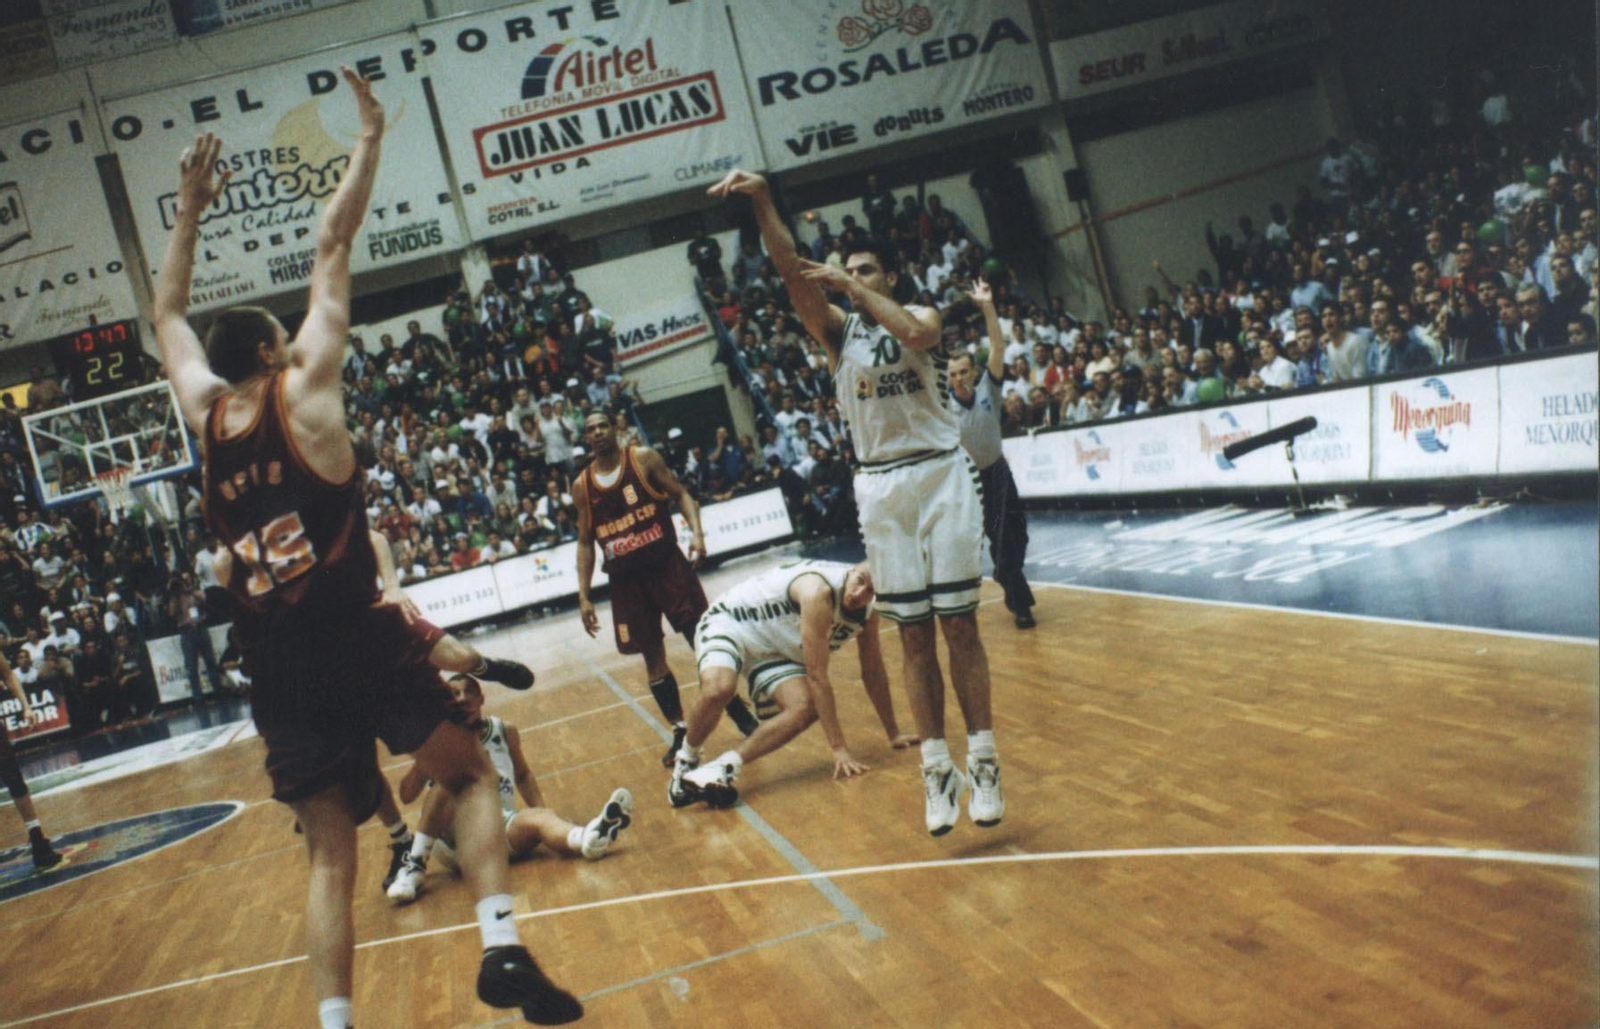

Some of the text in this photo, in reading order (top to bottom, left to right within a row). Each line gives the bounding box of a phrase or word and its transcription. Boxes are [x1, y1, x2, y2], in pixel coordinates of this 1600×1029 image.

[554, 37, 658, 92] Airtel
[630, 67, 681, 87] DIGITAL
[757, 17, 1032, 107] ROSALEDA
[1079, 53, 1146, 86] SEUR
[490, 83, 713, 165] JUAN LUCAS
[785, 123, 859, 157] VIE
[873, 104, 945, 137] donuts
[963, 86, 1034, 117] MONTERO
[215, 146, 300, 175] OSTRES
[510, 157, 591, 184] VIDA
[241, 202, 316, 232] Calidad
[368, 227, 443, 261] FUNDUS
[87, 351, 124, 384] 22
[1391, 390, 1471, 442] Menorquina
[233, 511, 318, 596] 15
